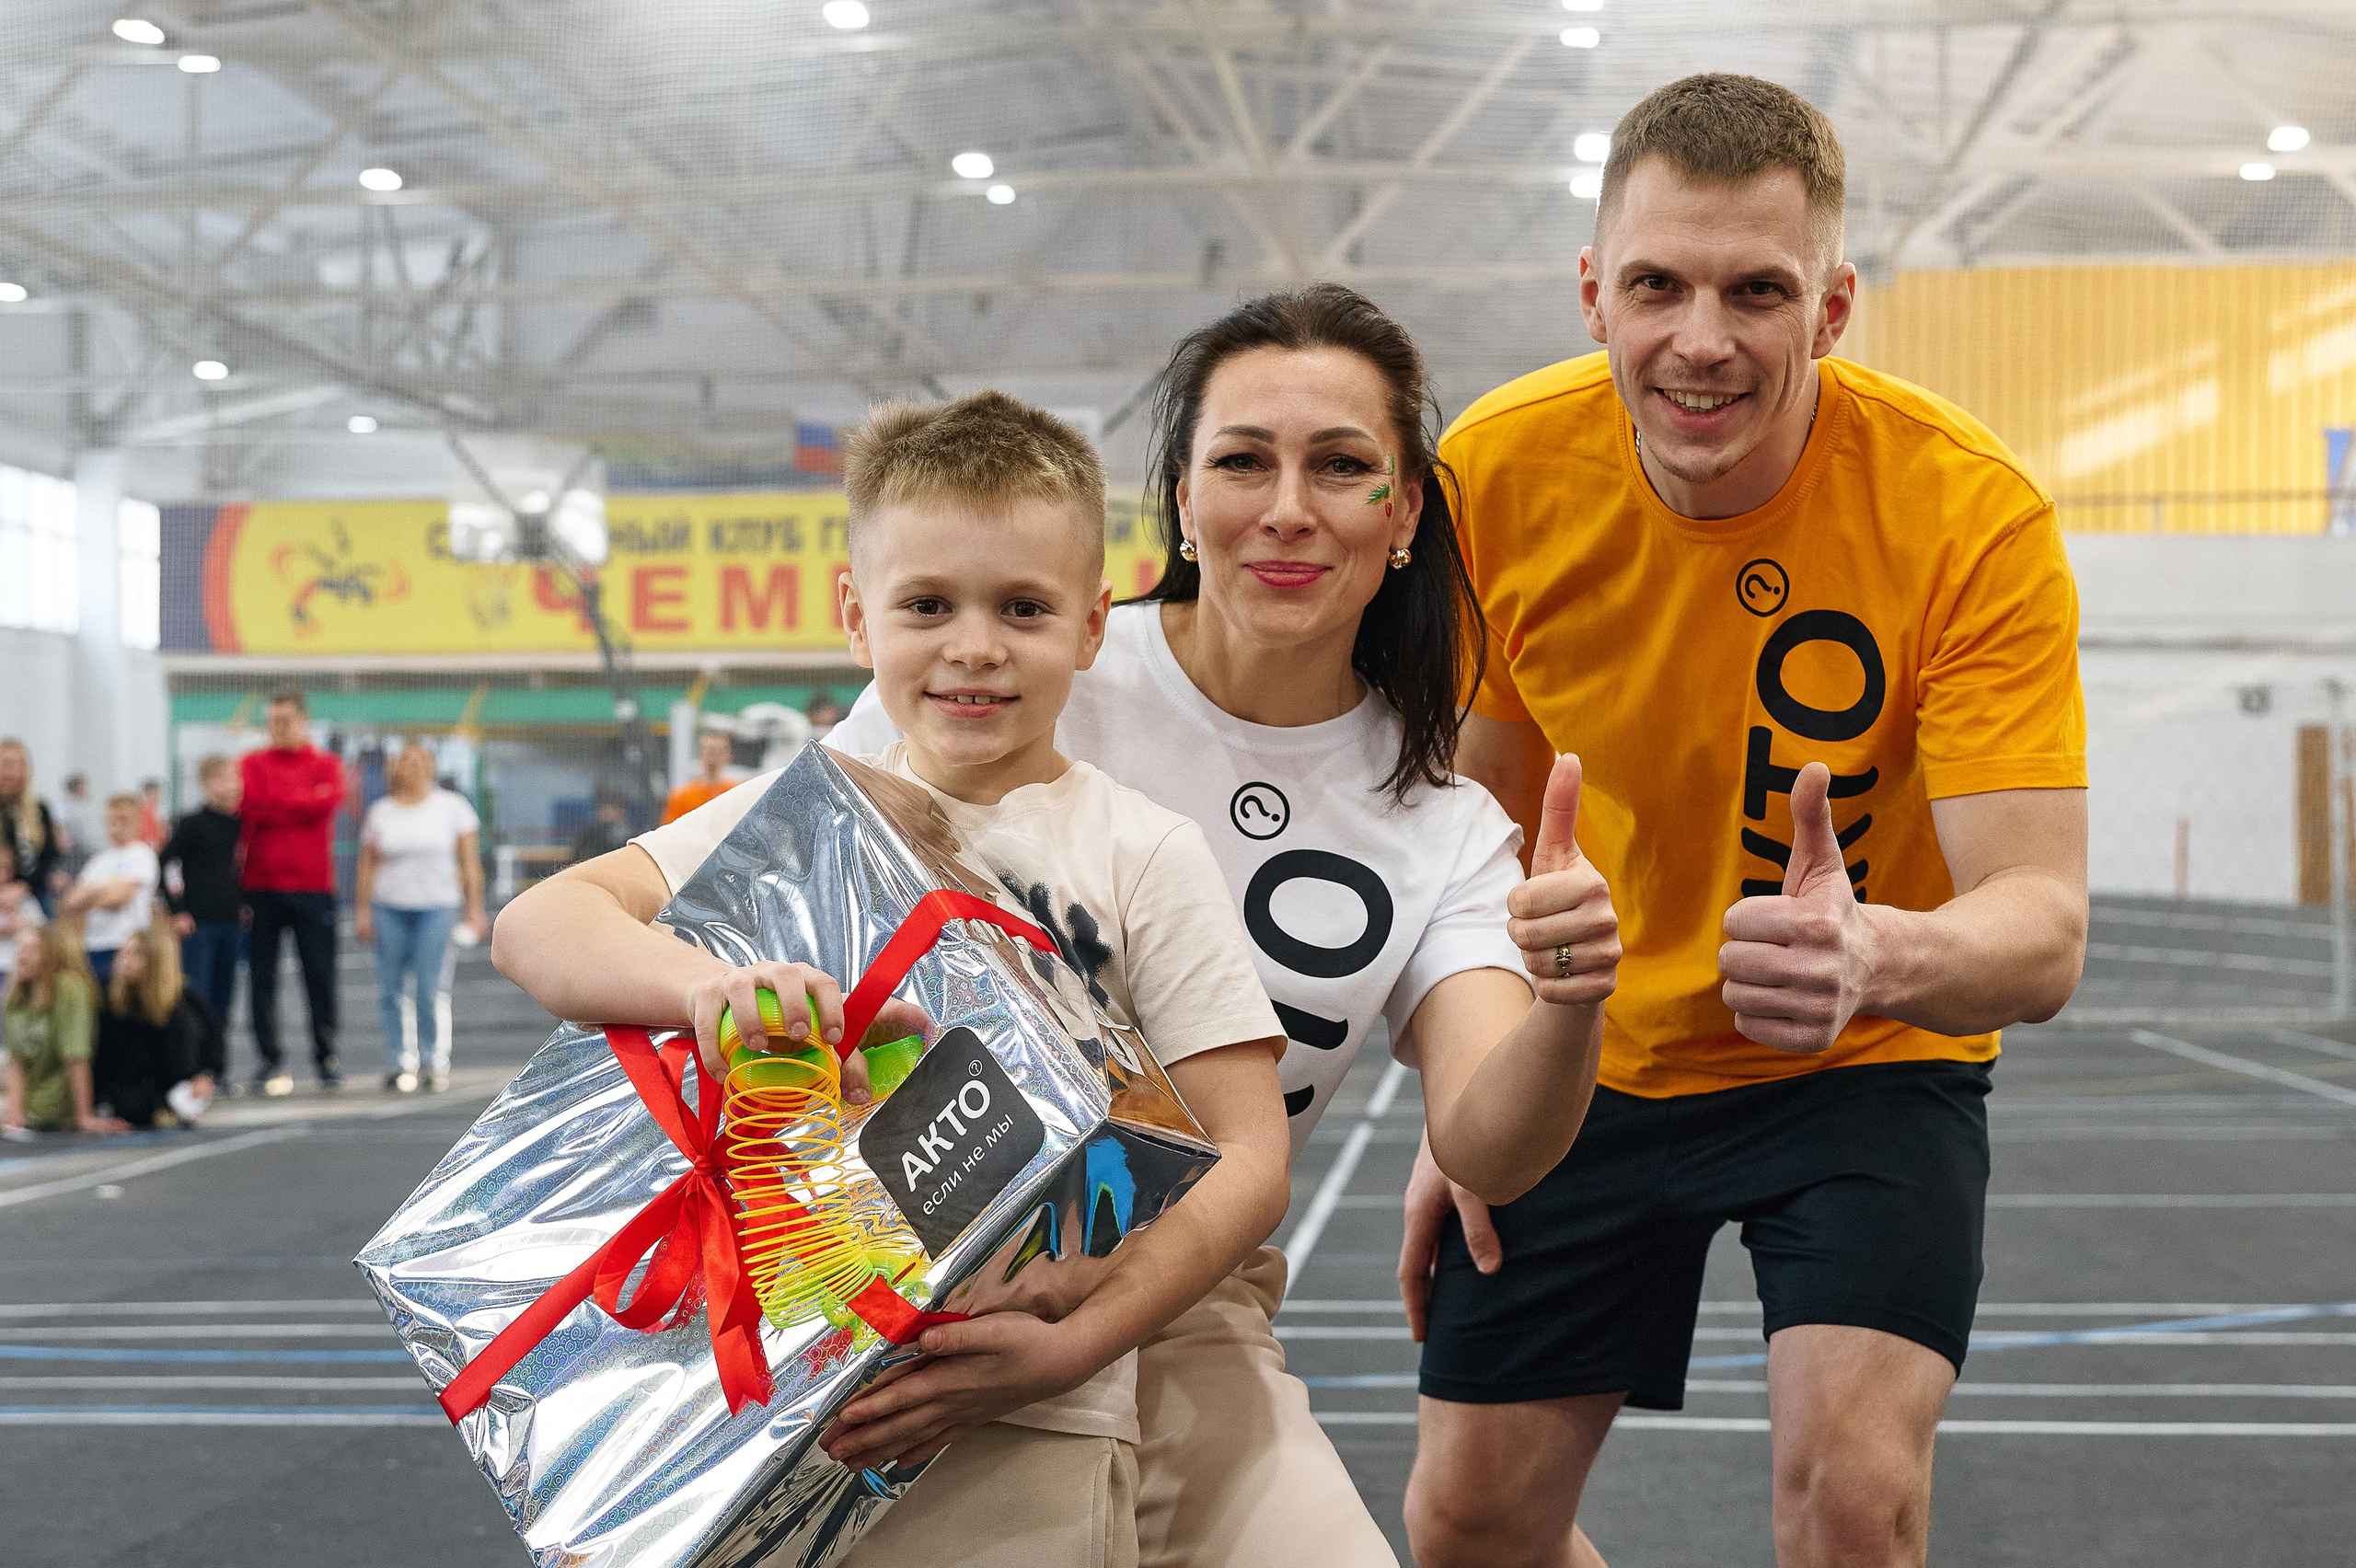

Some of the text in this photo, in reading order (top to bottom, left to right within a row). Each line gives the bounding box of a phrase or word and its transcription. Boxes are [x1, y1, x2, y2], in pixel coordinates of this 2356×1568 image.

[1740, 609, 1886, 903] КТО
[901, 1079, 990, 1193] АКТО
[923, 1113, 1014, 1216] если не мы
